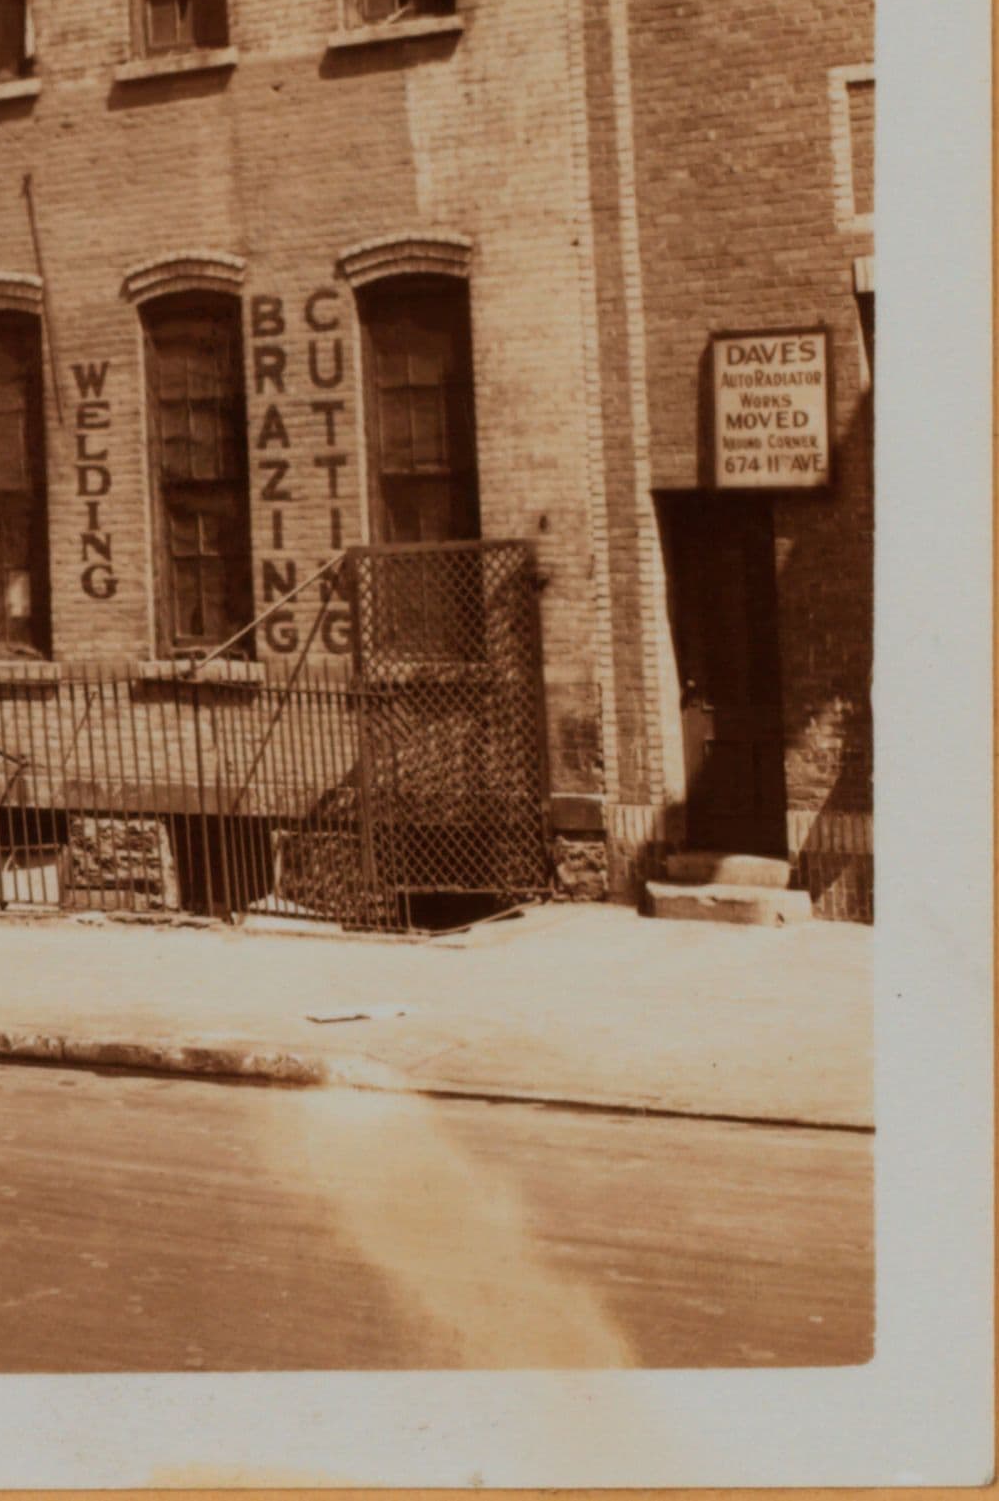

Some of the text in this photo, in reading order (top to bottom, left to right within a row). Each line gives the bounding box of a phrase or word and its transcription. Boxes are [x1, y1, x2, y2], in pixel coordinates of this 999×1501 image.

[70, 360, 119, 600] WELDING
[250, 295, 300, 653] BRAZING
[725, 455, 761, 474] 674
[726, 410, 809, 430] MOVED
